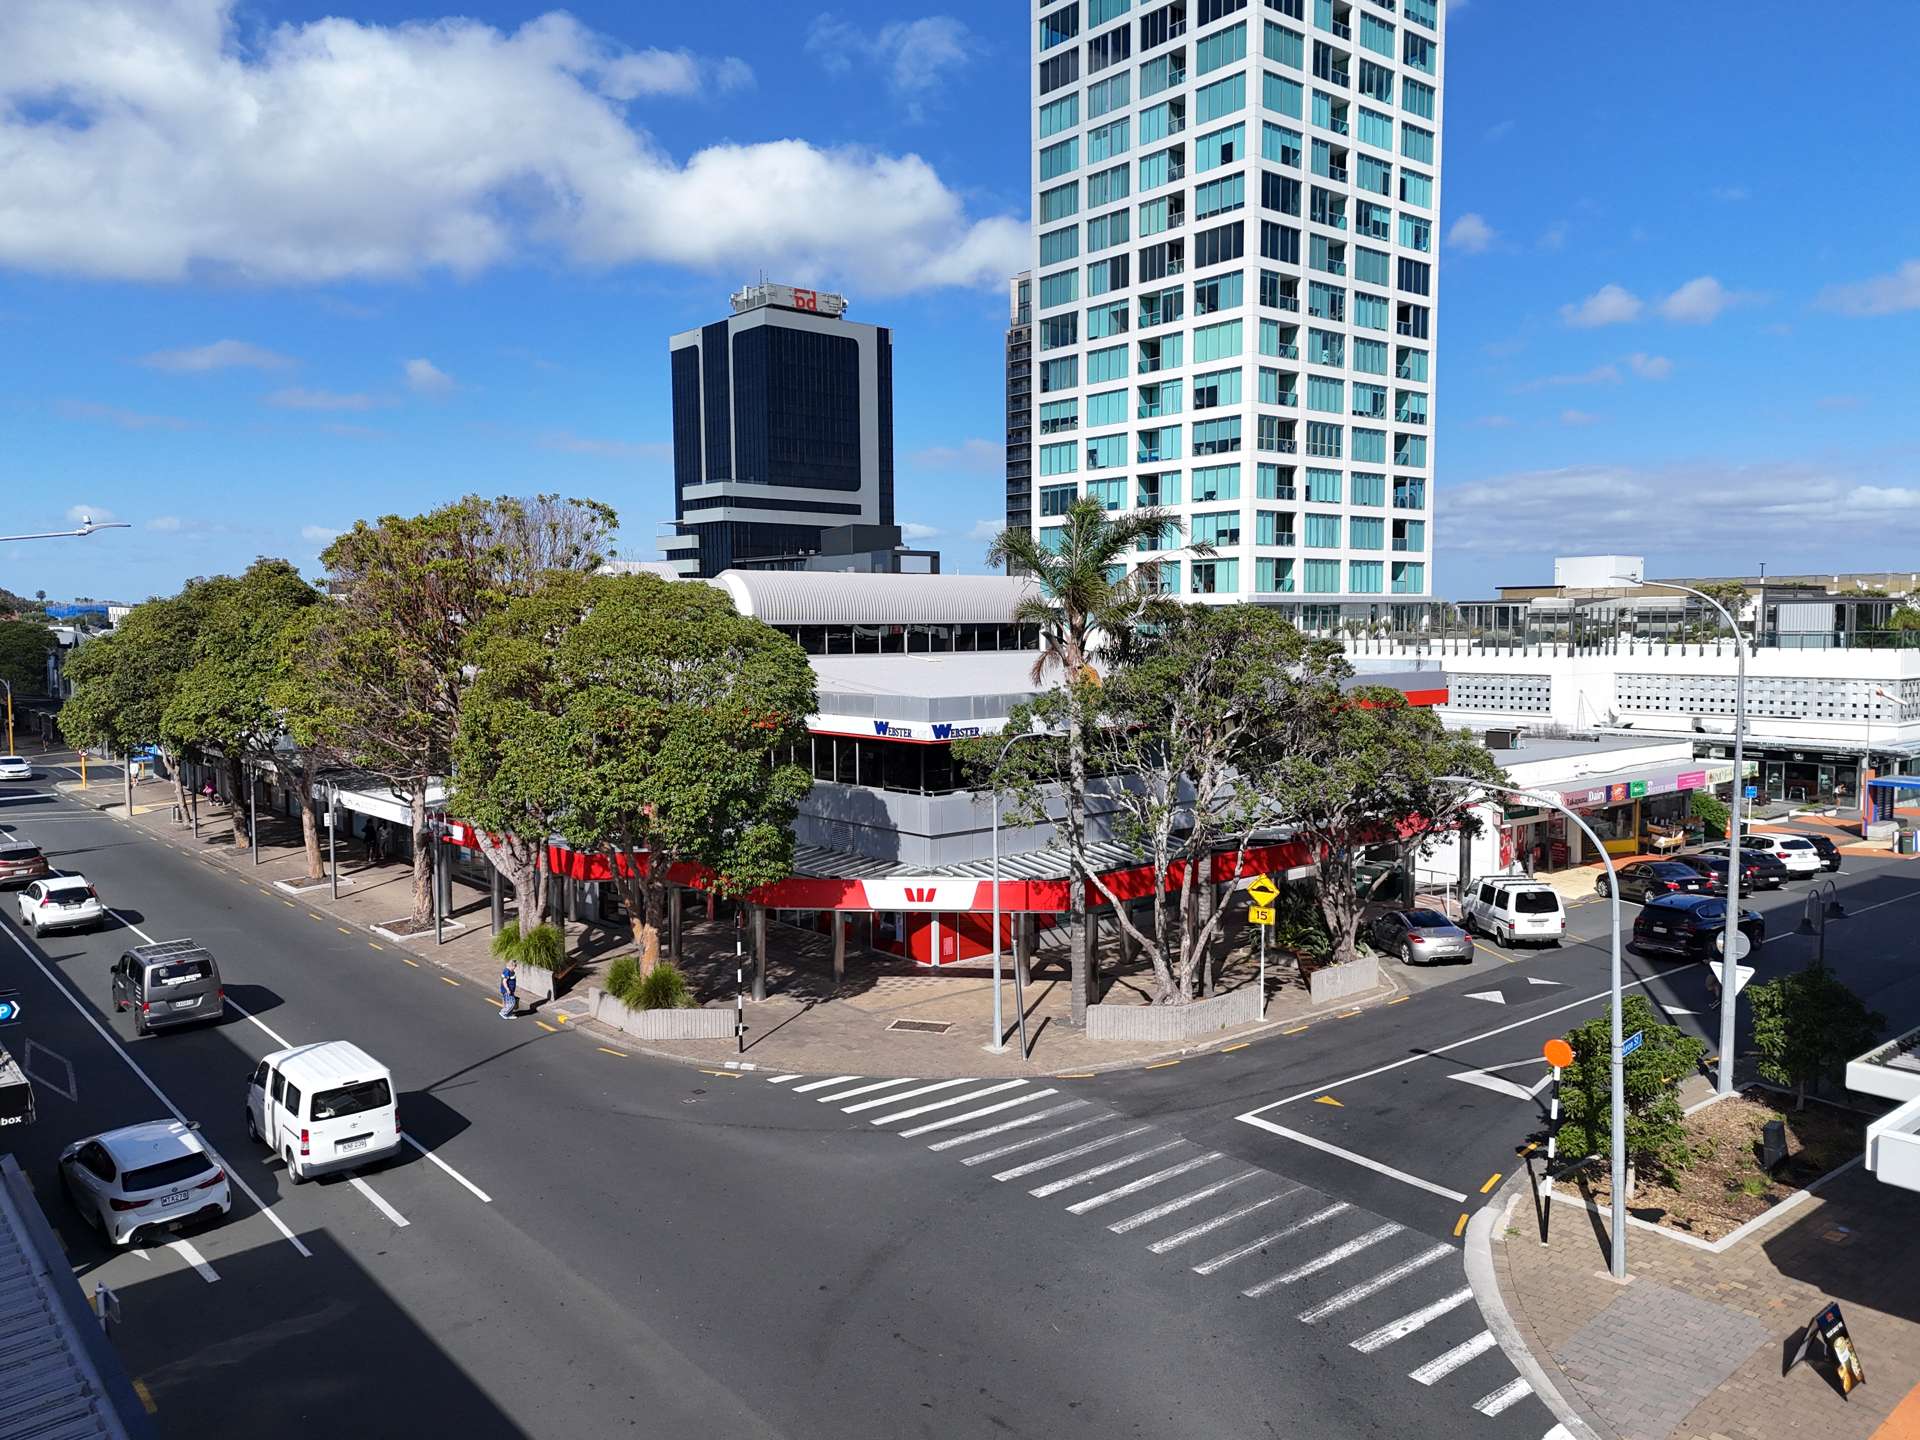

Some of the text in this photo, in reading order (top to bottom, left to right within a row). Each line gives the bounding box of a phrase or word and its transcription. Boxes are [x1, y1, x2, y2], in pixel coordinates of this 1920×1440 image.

[874, 721, 912, 738] WEBSTER
[931, 724, 980, 739] WEBSTER
[1588, 791, 1605, 804] Dairy
[1256, 910, 1268, 921] 15
